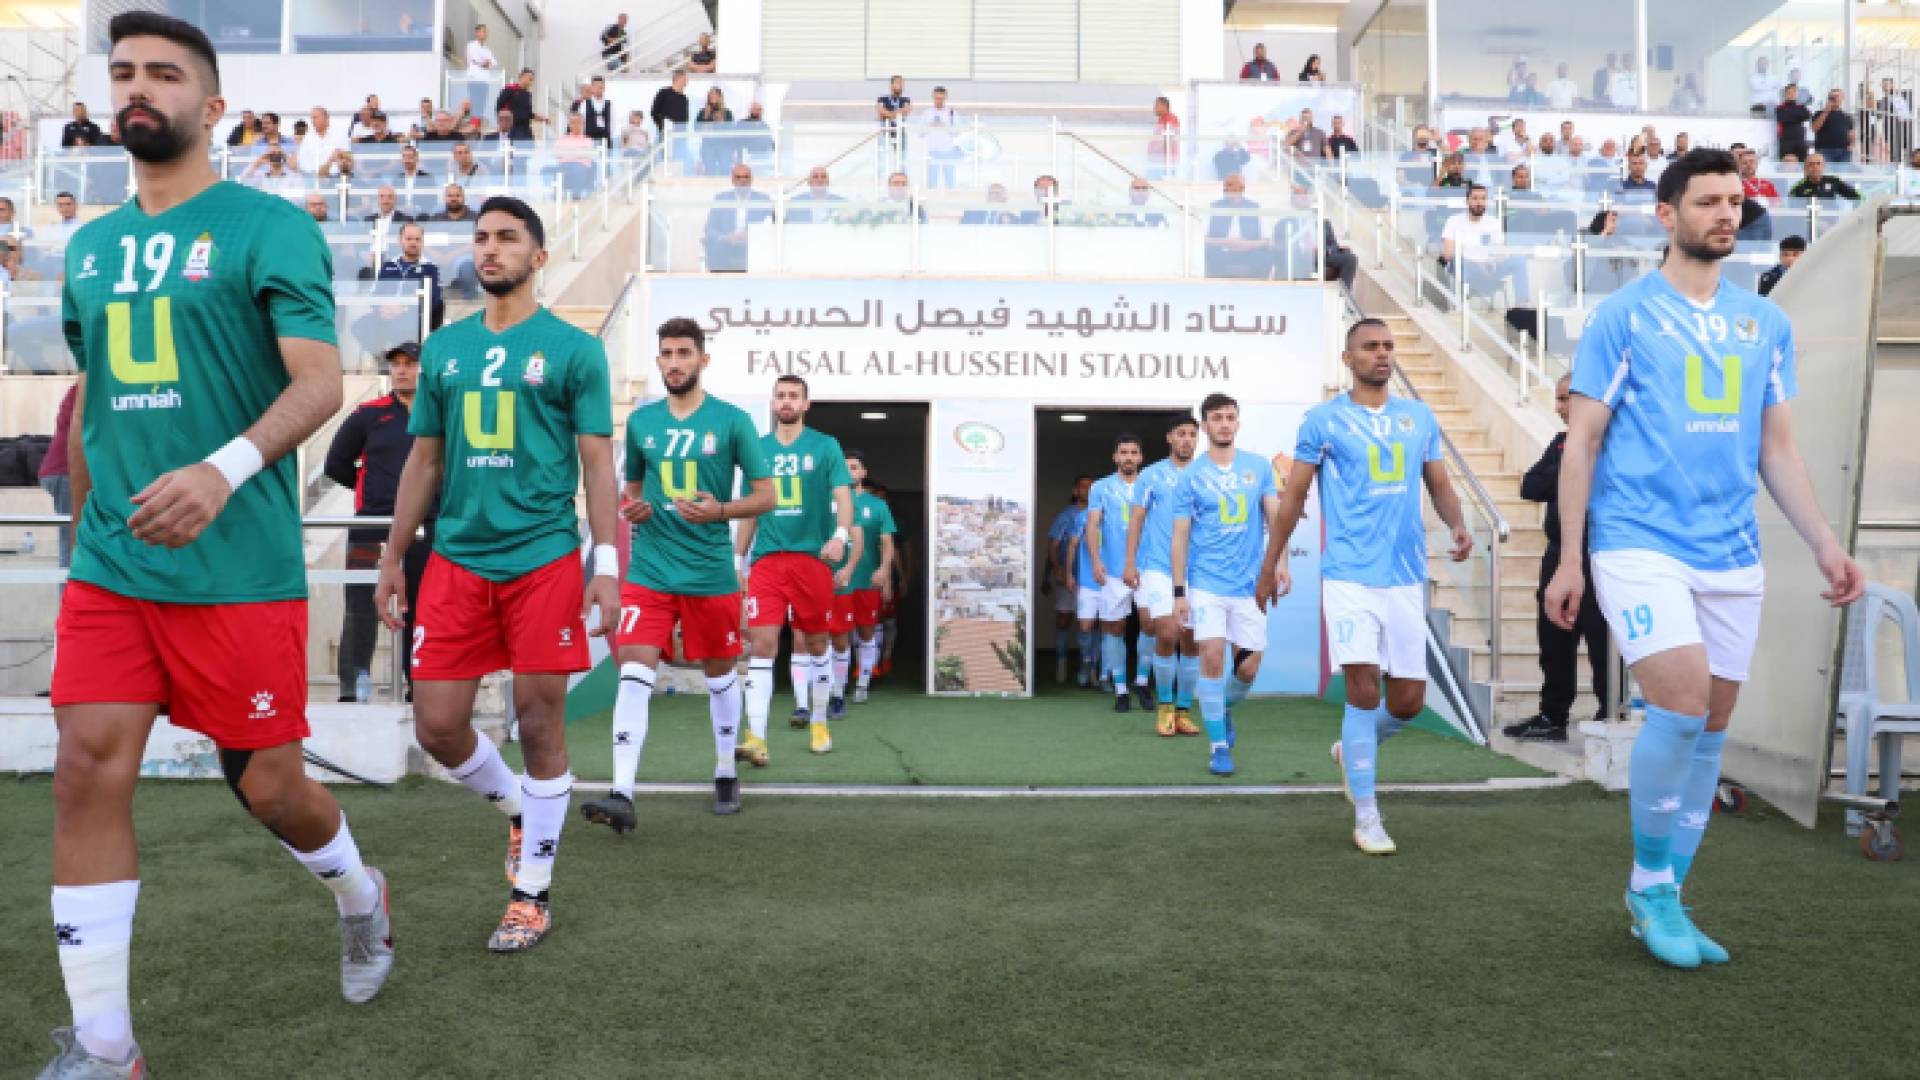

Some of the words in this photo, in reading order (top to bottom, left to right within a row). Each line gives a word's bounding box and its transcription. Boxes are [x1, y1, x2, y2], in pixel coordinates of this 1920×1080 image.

[113, 231, 176, 294] 19
[702, 298, 884, 342] الحسيني
[896, 297, 1011, 336] فيصل
[1026, 294, 1170, 338] الشهيد
[1185, 303, 1288, 335] ستاد
[1692, 313, 1728, 343] 19
[482, 346, 507, 387] 2
[747, 350, 851, 376] FAISAL
[863, 350, 1068, 377] AL-HUSSEINI
[1080, 352, 1230, 381] STADIUM
[111, 385, 182, 411] umniah
[663, 428, 696, 458] 77
[773, 453, 798, 476] 23
[1622, 603, 1653, 640] 19
